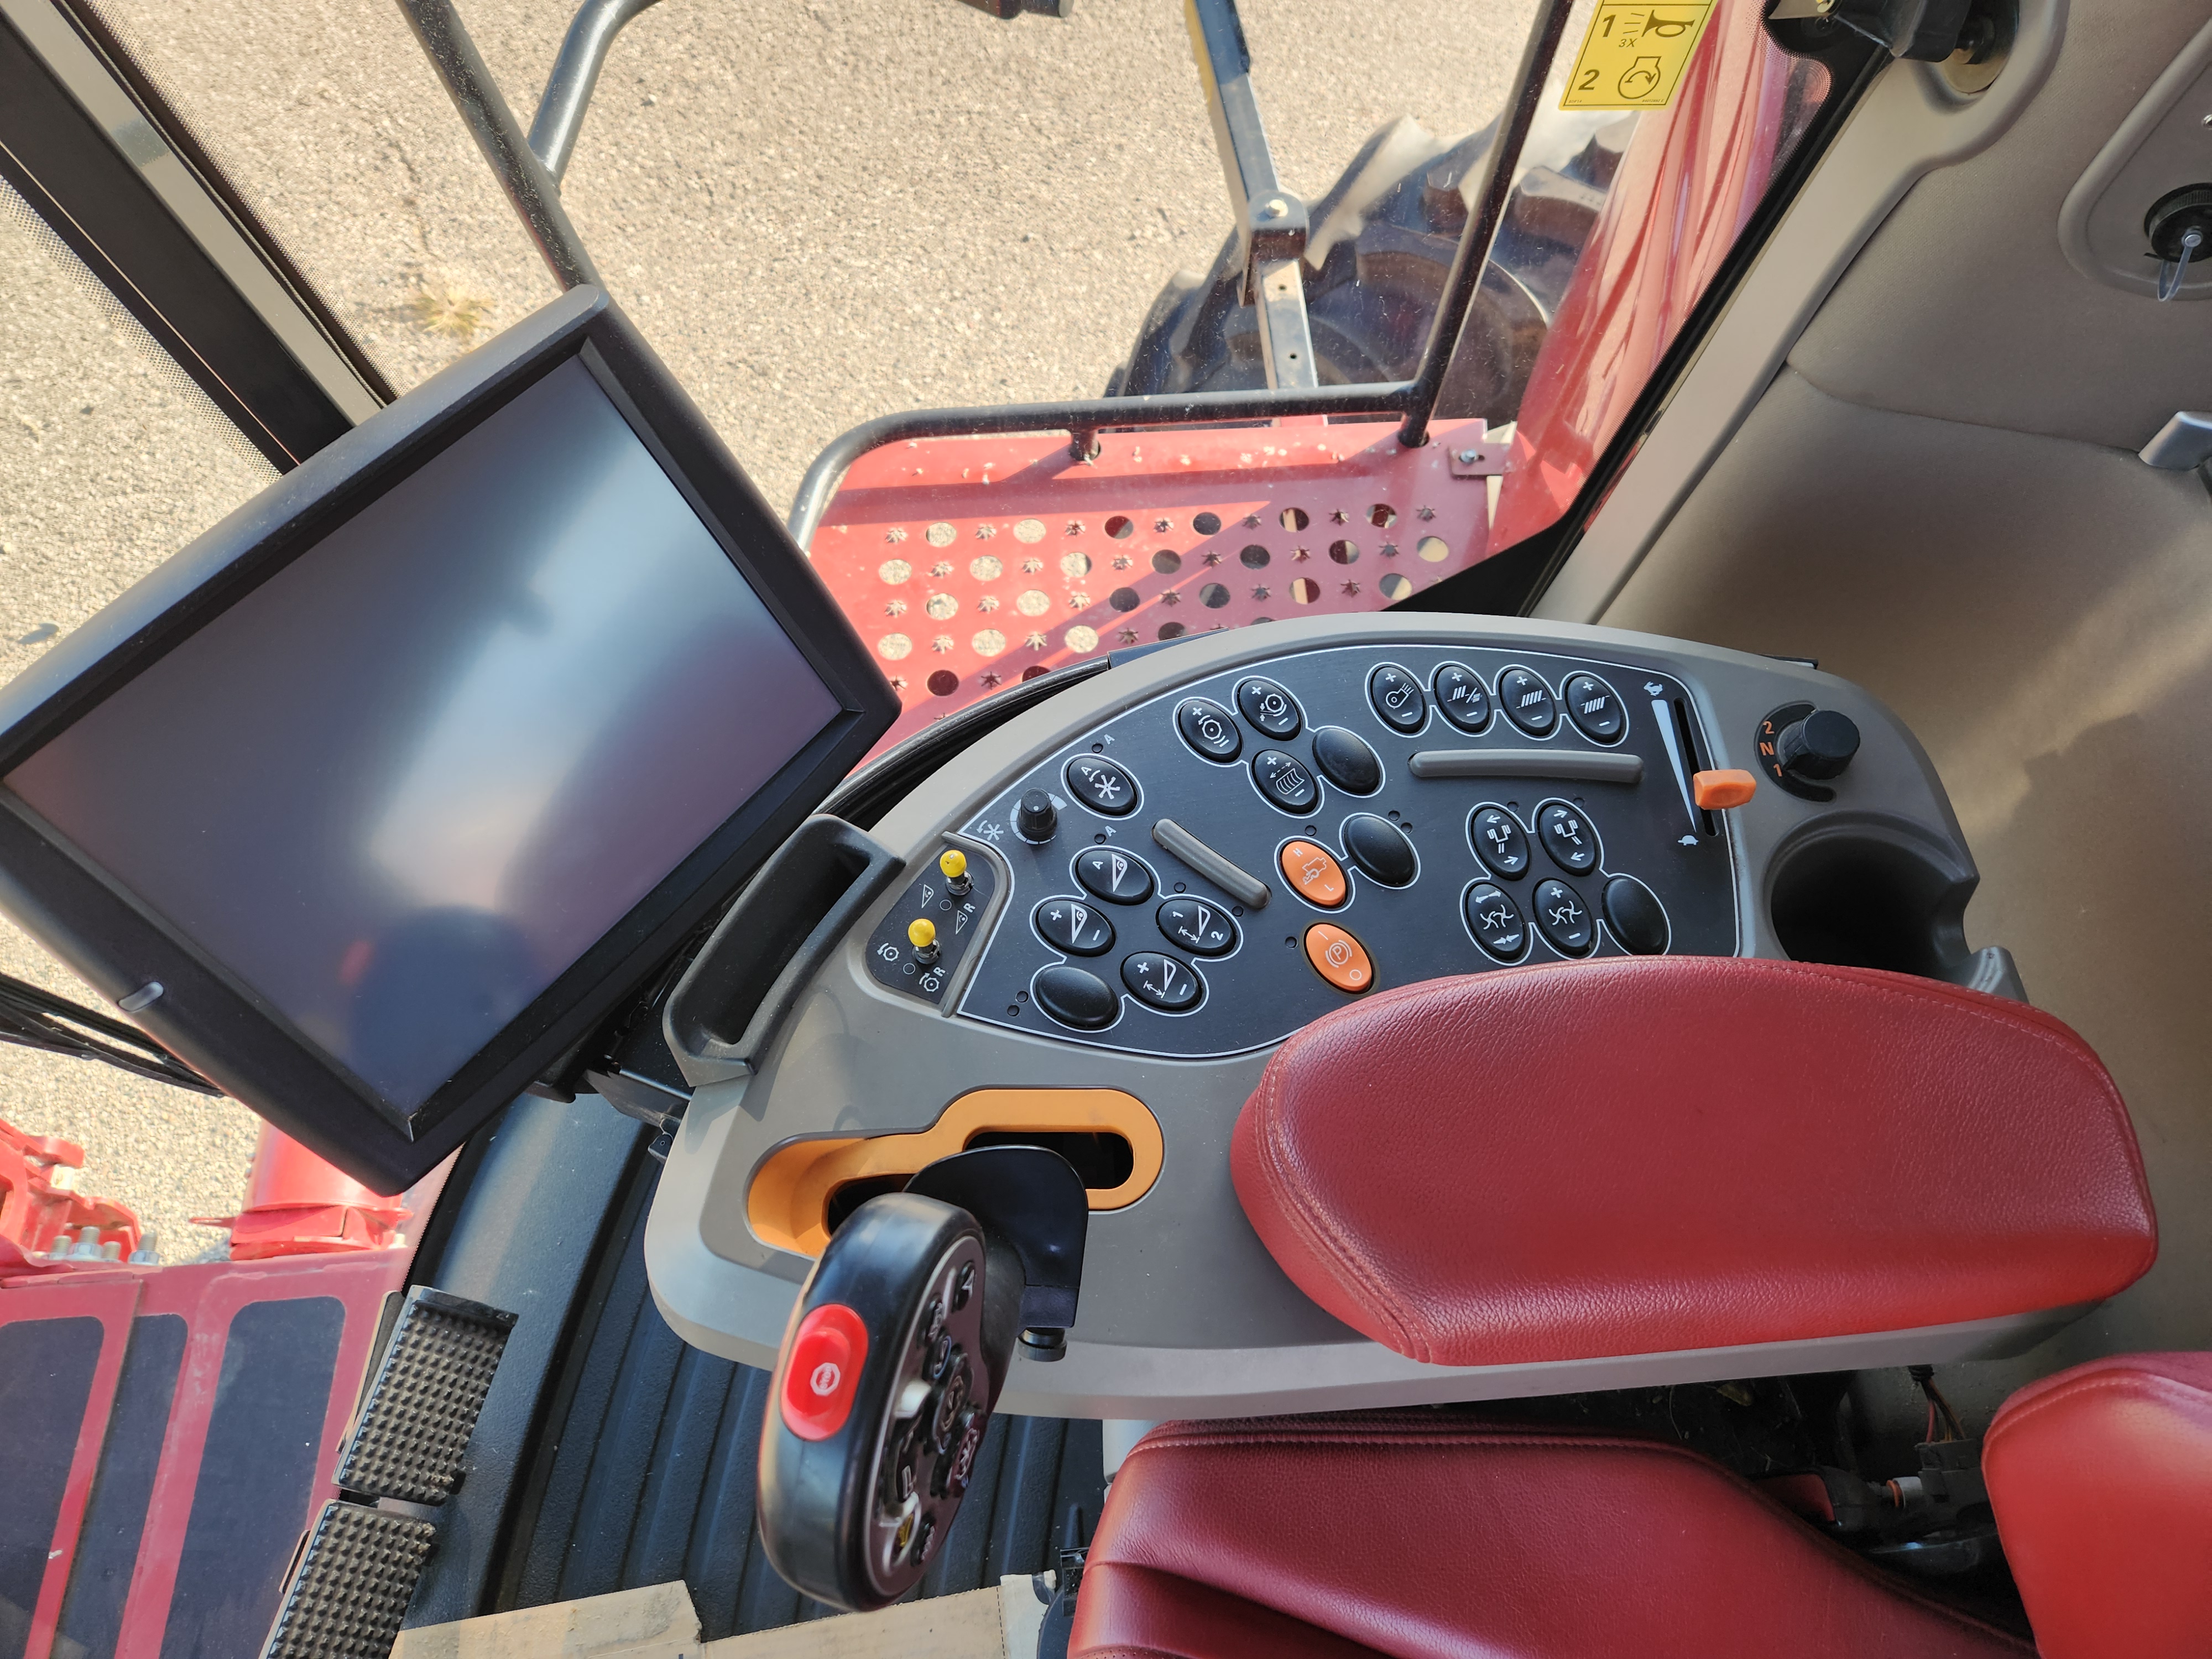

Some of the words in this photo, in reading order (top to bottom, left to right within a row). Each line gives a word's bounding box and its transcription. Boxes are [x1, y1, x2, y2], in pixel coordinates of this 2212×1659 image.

[1603, 14, 1616, 37] 1
[1619, 38, 1637, 48] 3X
[1578, 69, 1600, 90] 2
[1762, 721, 1775, 734] 2
[1104, 734, 1115, 745] A
[1759, 742, 1775, 756] N
[1081, 766, 1092, 776] A
[1773, 763, 1782, 777] 1
[1105, 825, 1117, 837] A
[1293, 848, 1303, 857] H
[1092, 861, 1104, 870] A
[963, 902, 976, 913] R
[1211, 931, 1224, 941] 2
[1332, 945, 1342, 961] P
[933, 967, 946, 977] R
